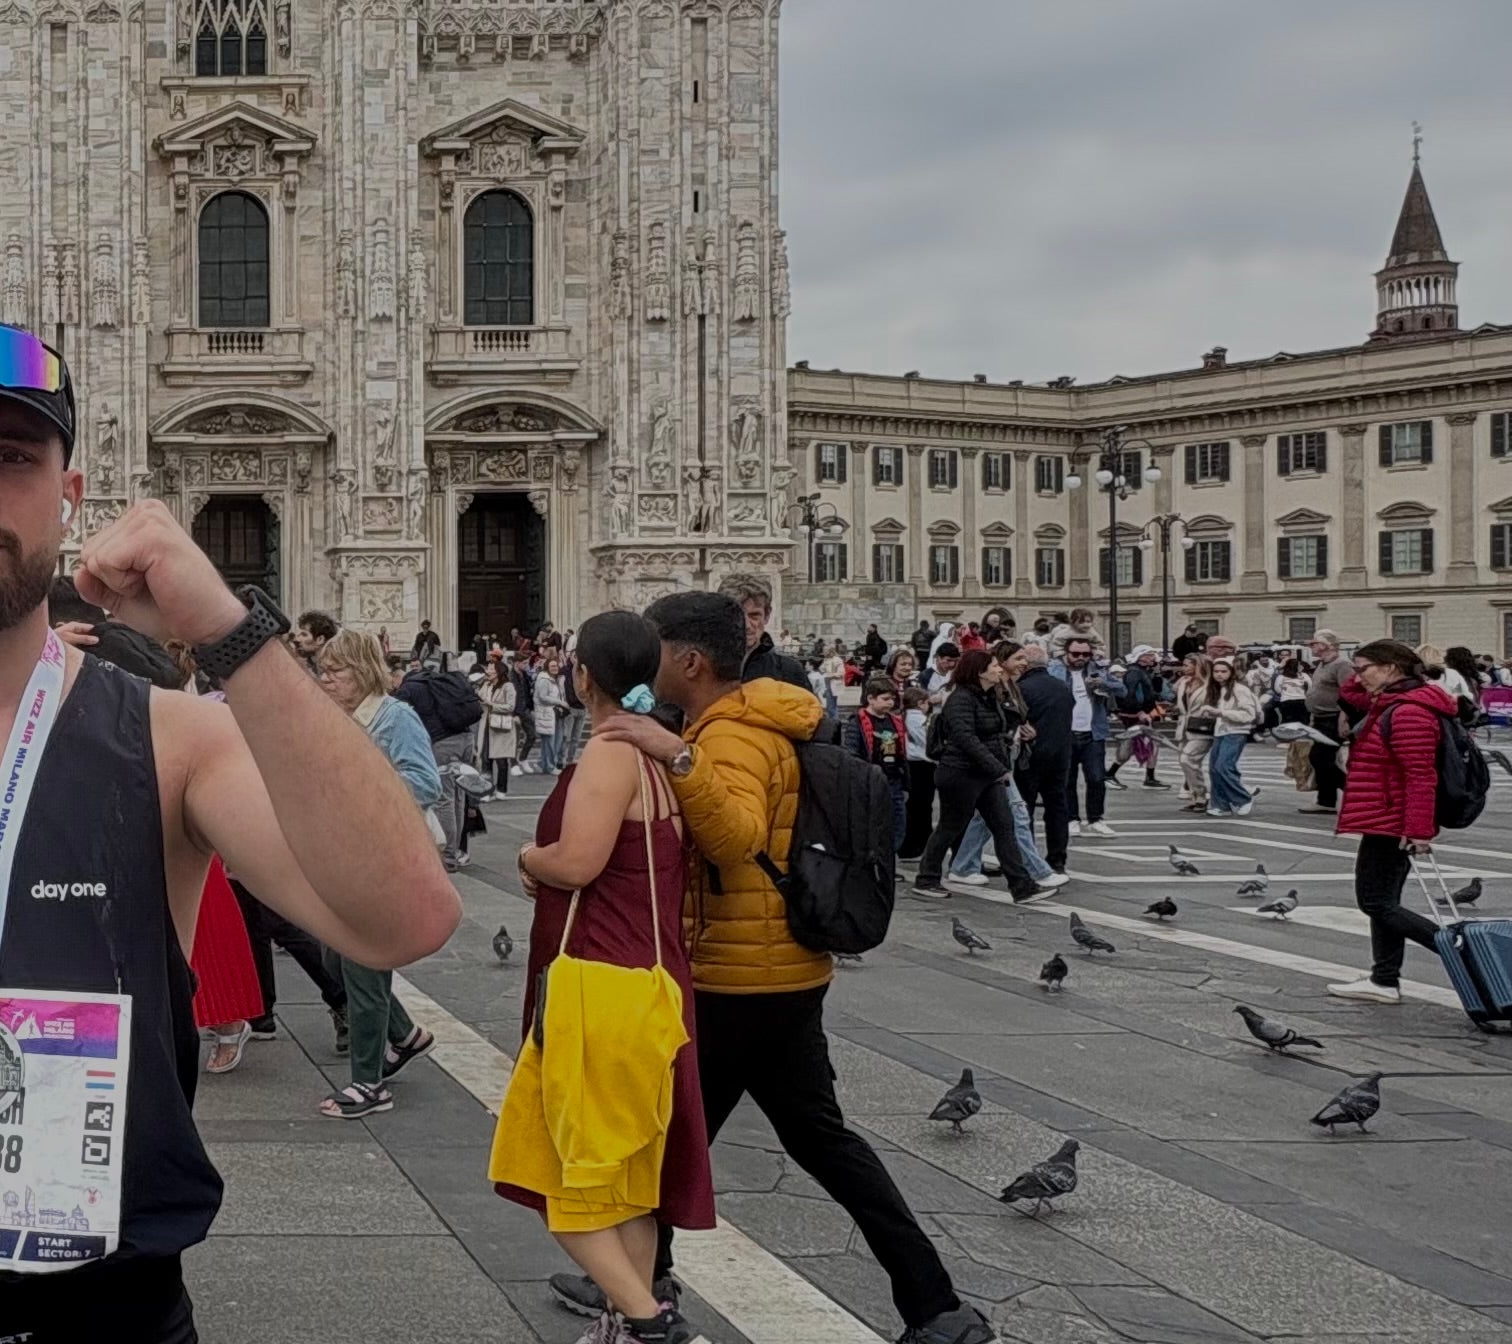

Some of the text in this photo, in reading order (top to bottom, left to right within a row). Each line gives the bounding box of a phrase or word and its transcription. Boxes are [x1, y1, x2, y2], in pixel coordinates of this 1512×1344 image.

[29, 689, 47, 718] WIZZ
[21, 719, 37, 745] AIR
[4, 747, 27, 804] MILANO
[37, 1236, 72, 1247] START
[84, 1249, 92, 1259] 7
